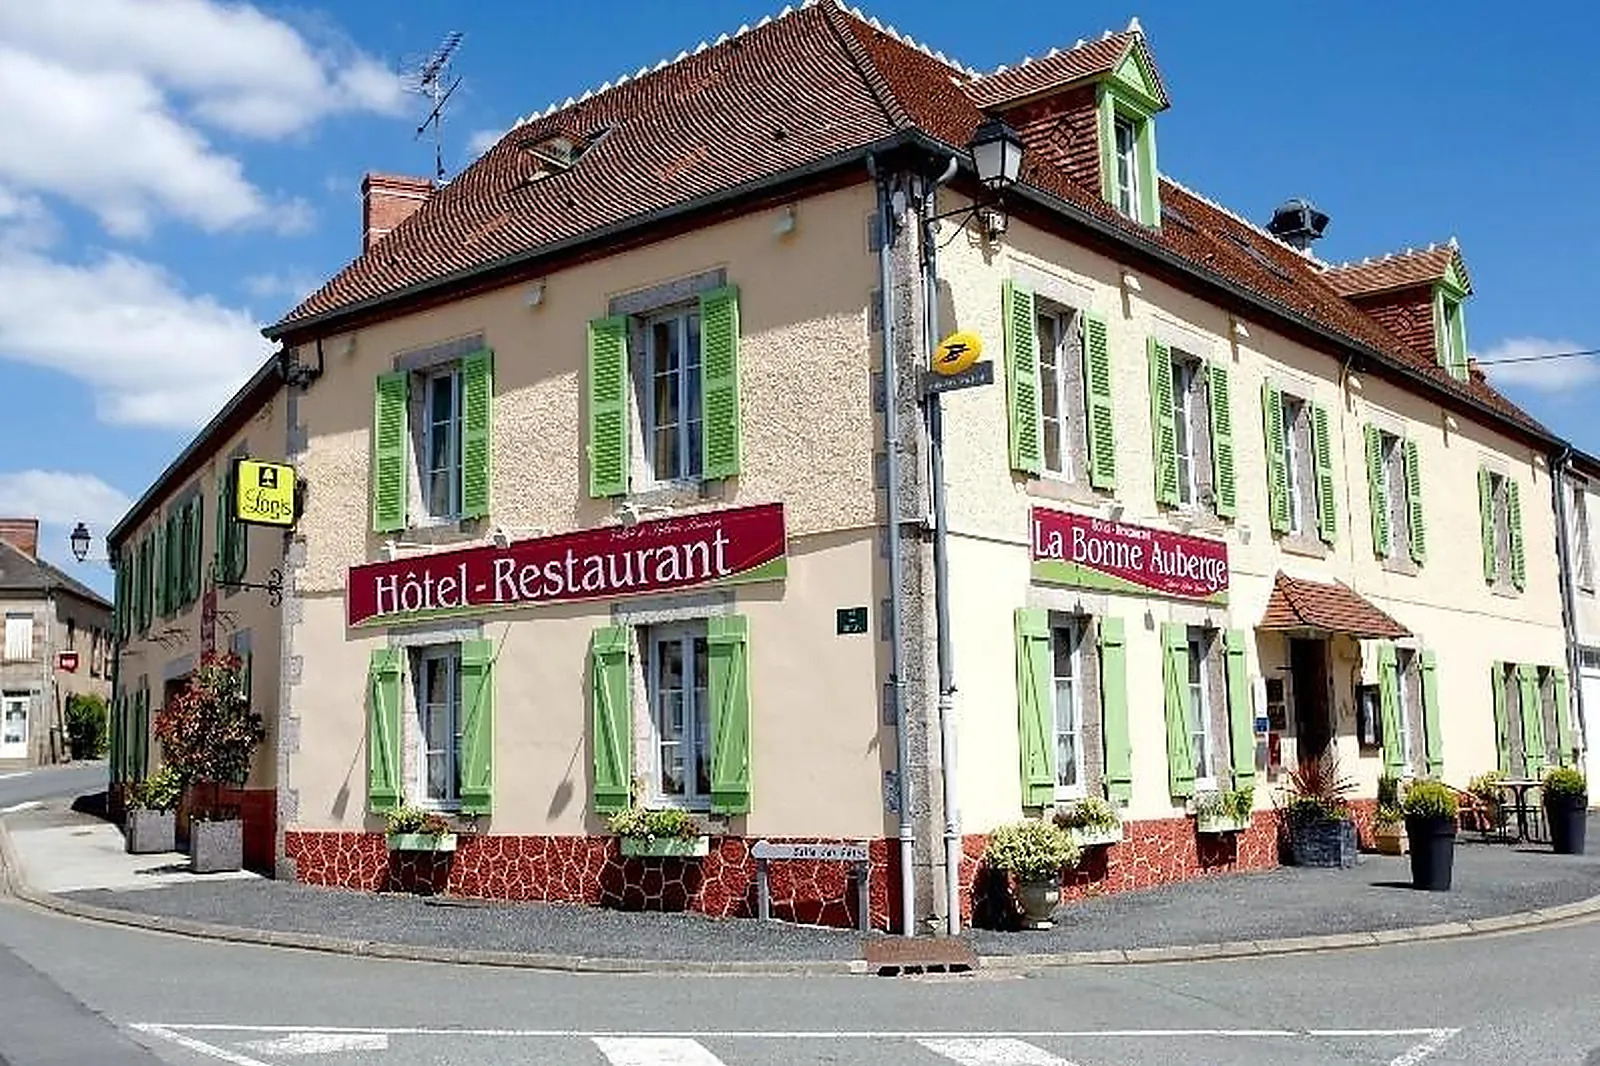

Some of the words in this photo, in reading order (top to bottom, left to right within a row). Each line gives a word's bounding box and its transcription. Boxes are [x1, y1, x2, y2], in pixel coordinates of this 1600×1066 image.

[375, 562, 470, 616] Hôtel
[494, 528, 732, 603] Restaurant
[1034, 519, 1063, 558] La
[1072, 526, 1144, 571] Bonne
[1150, 541, 1228, 591] Auberge
